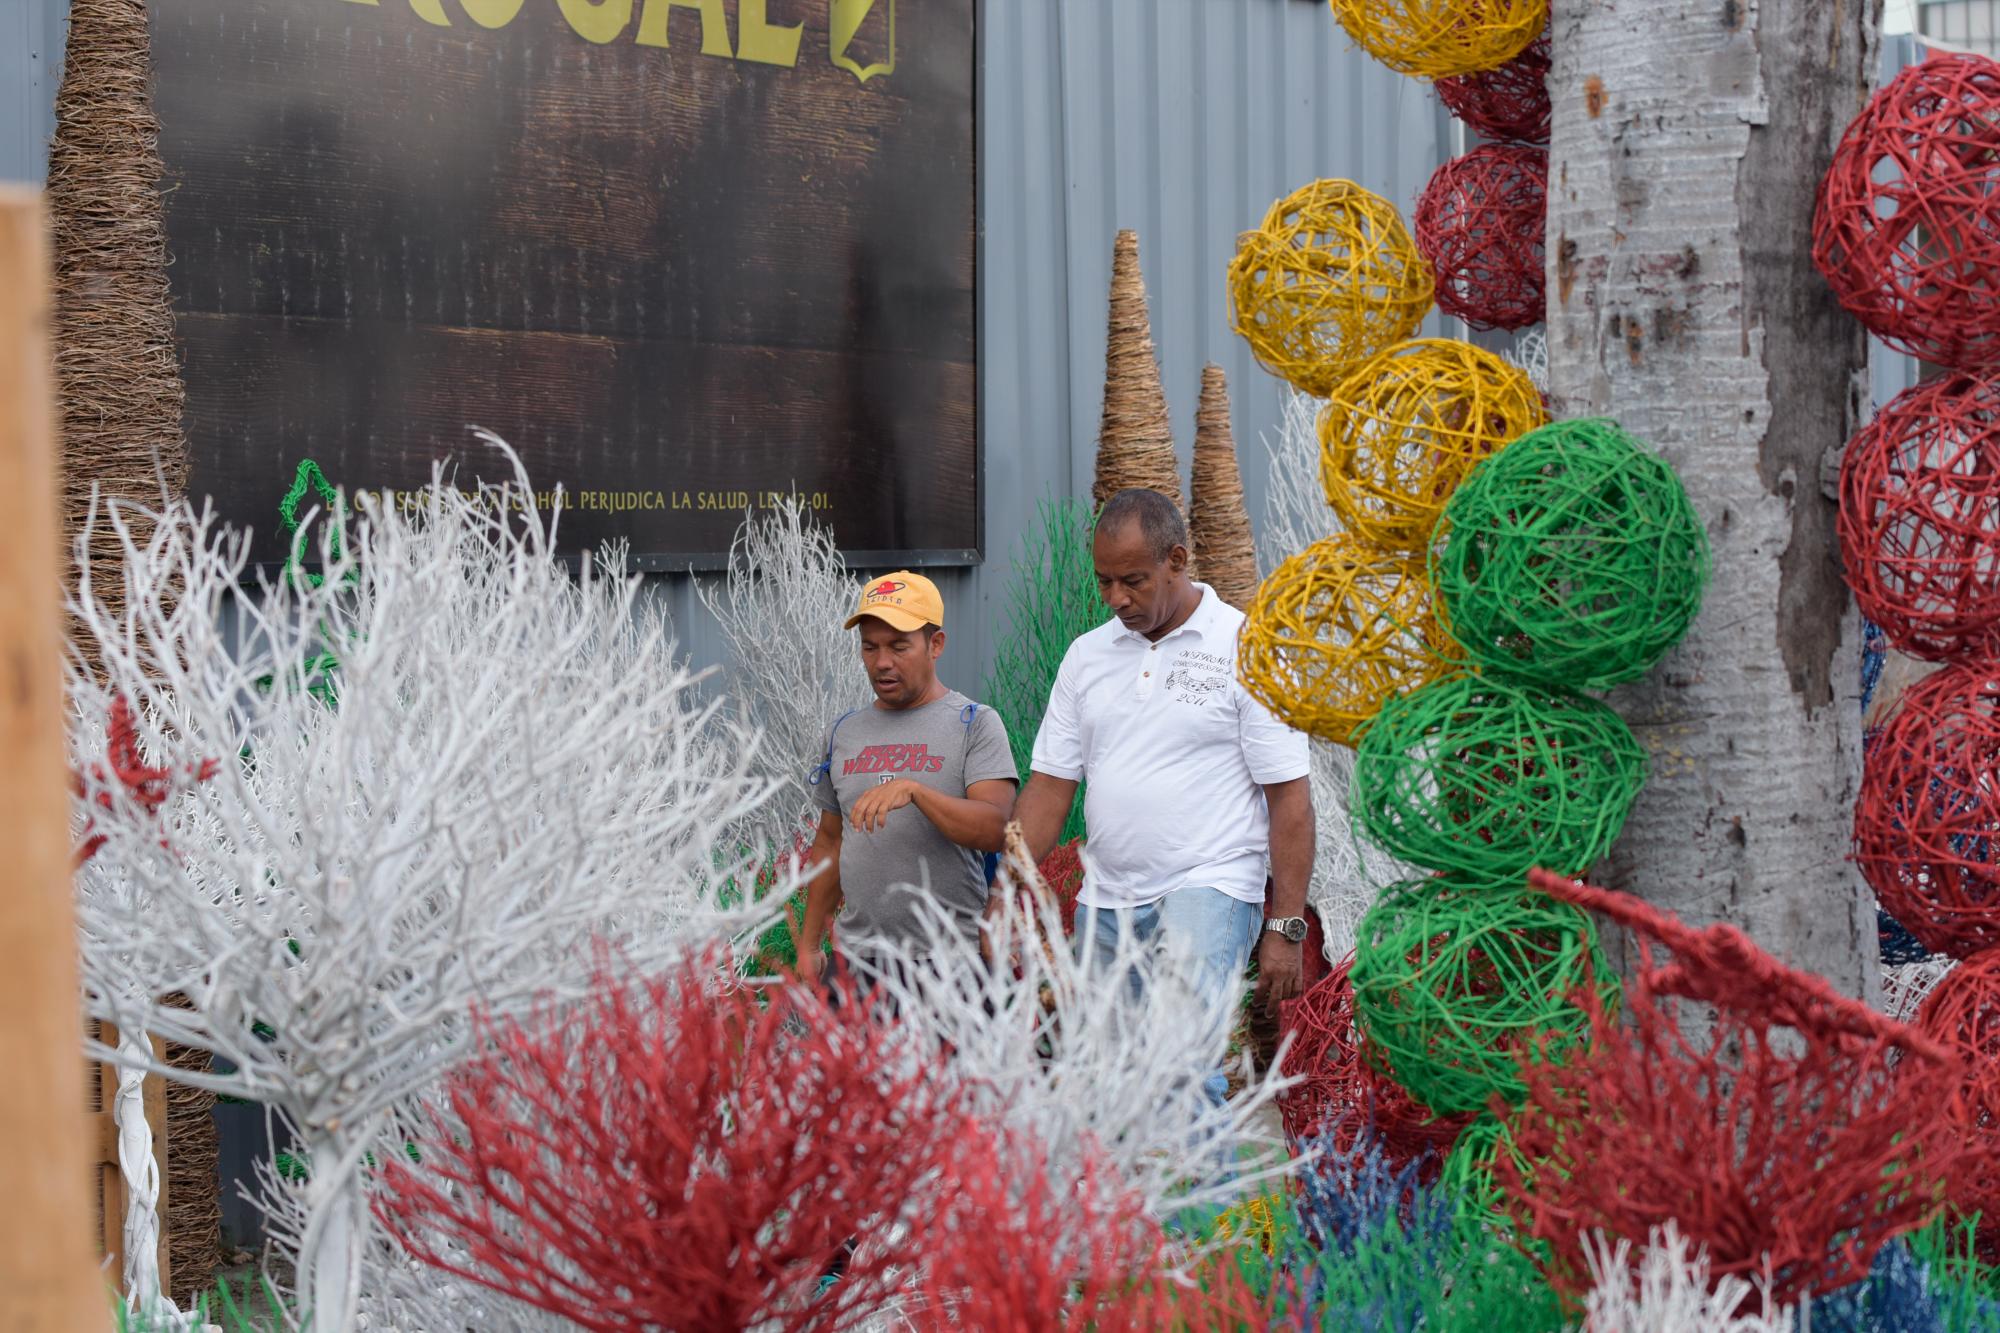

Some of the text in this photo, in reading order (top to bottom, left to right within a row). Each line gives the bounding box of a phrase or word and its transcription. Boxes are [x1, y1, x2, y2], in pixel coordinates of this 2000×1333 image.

[489, 491, 573, 511] ACHOL
[580, 491, 665, 514] PERJUDICA
[671, 491, 692, 509] LA
[788, 492, 832, 509] 2-01.
[1176, 693, 1208, 706] 2011
[856, 743, 928, 760] ARIZONA
[842, 753, 946, 776] WILDCATS
